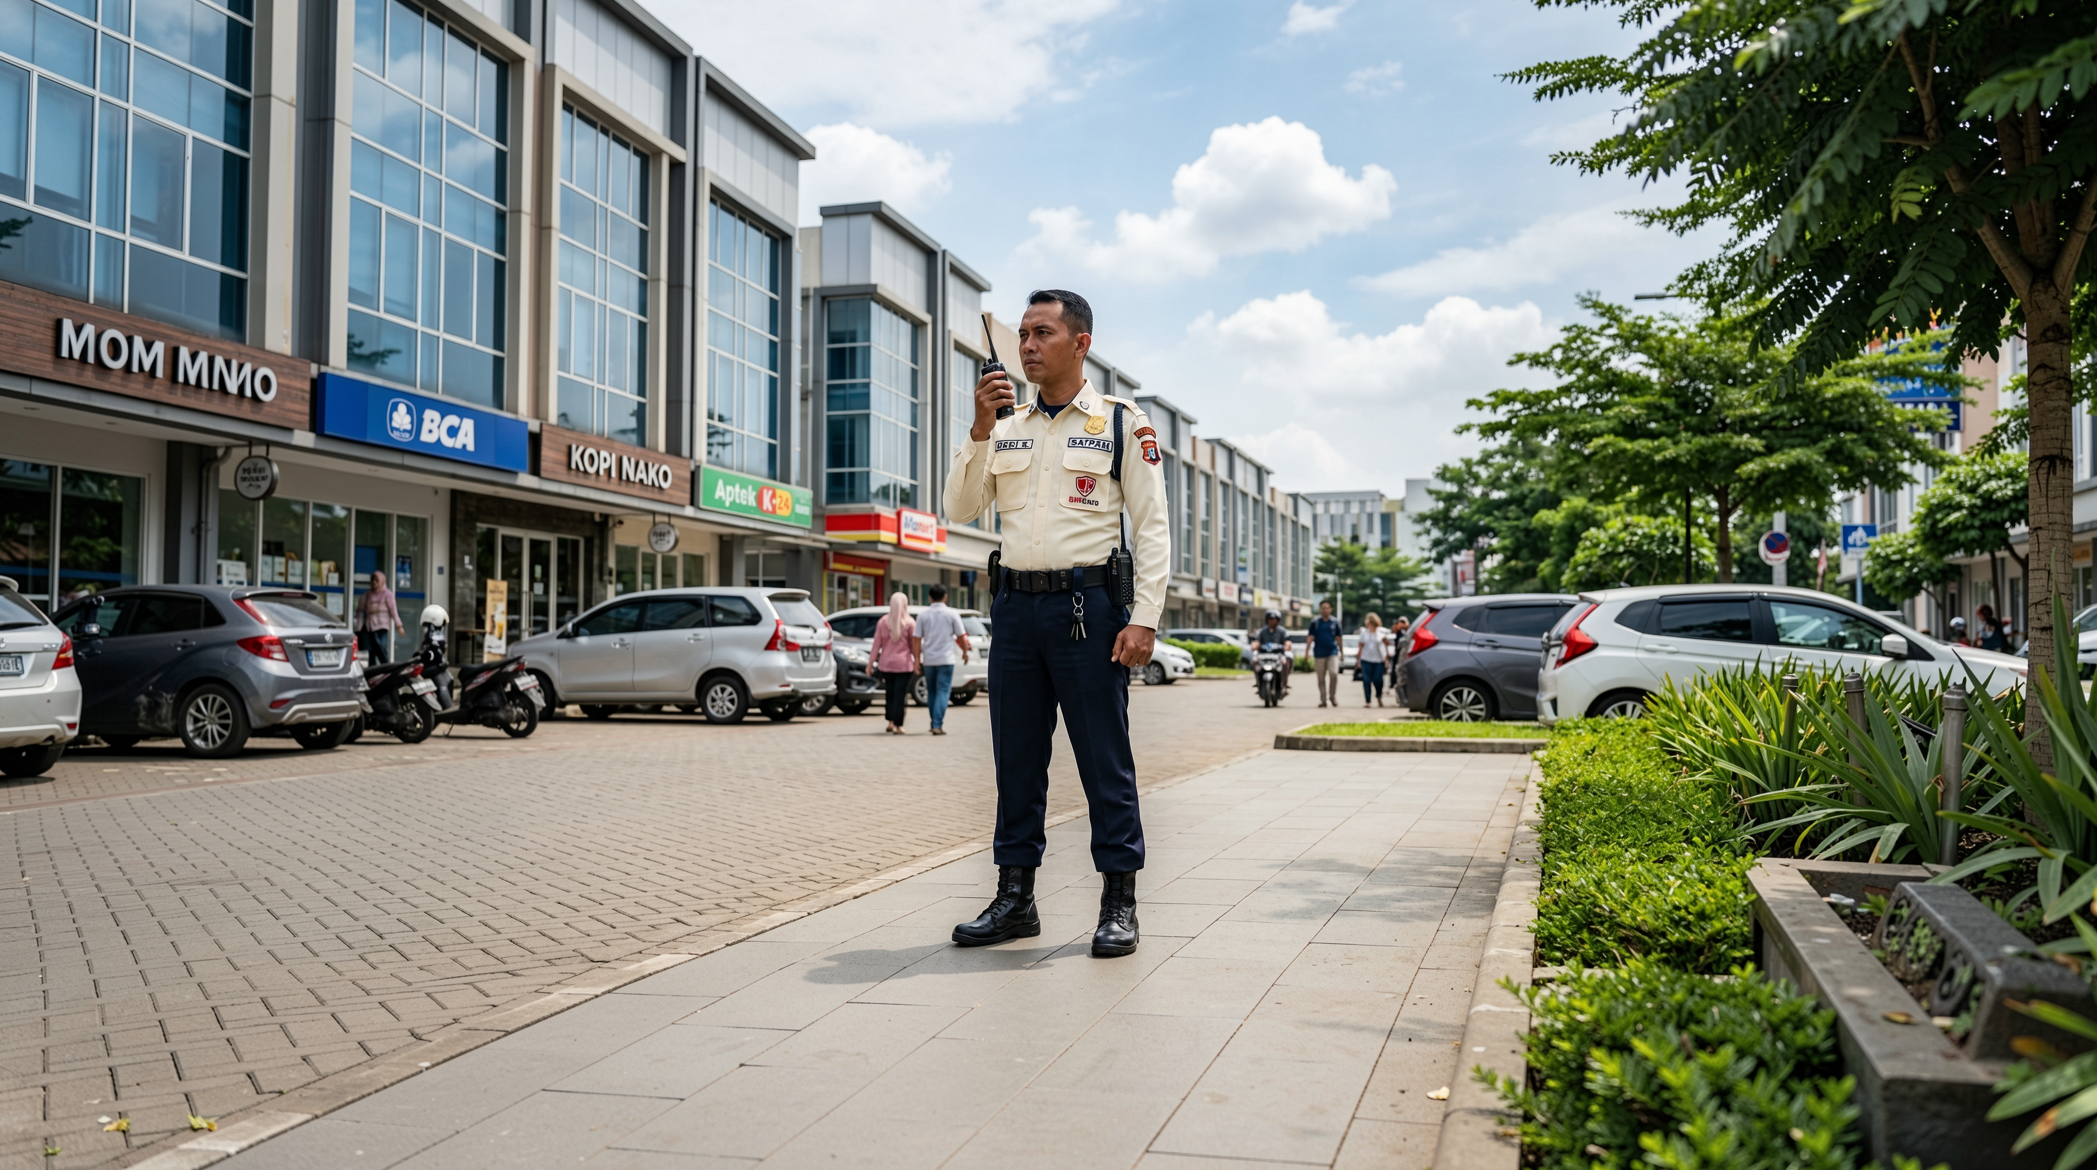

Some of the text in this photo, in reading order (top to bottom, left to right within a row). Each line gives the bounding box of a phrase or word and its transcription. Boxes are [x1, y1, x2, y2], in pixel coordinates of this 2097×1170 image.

[58, 317, 165, 379] MOM
[420, 408, 475, 452] BCA
[570, 443, 672, 490] KOPI NAKO
[714, 478, 757, 507] Aptek
